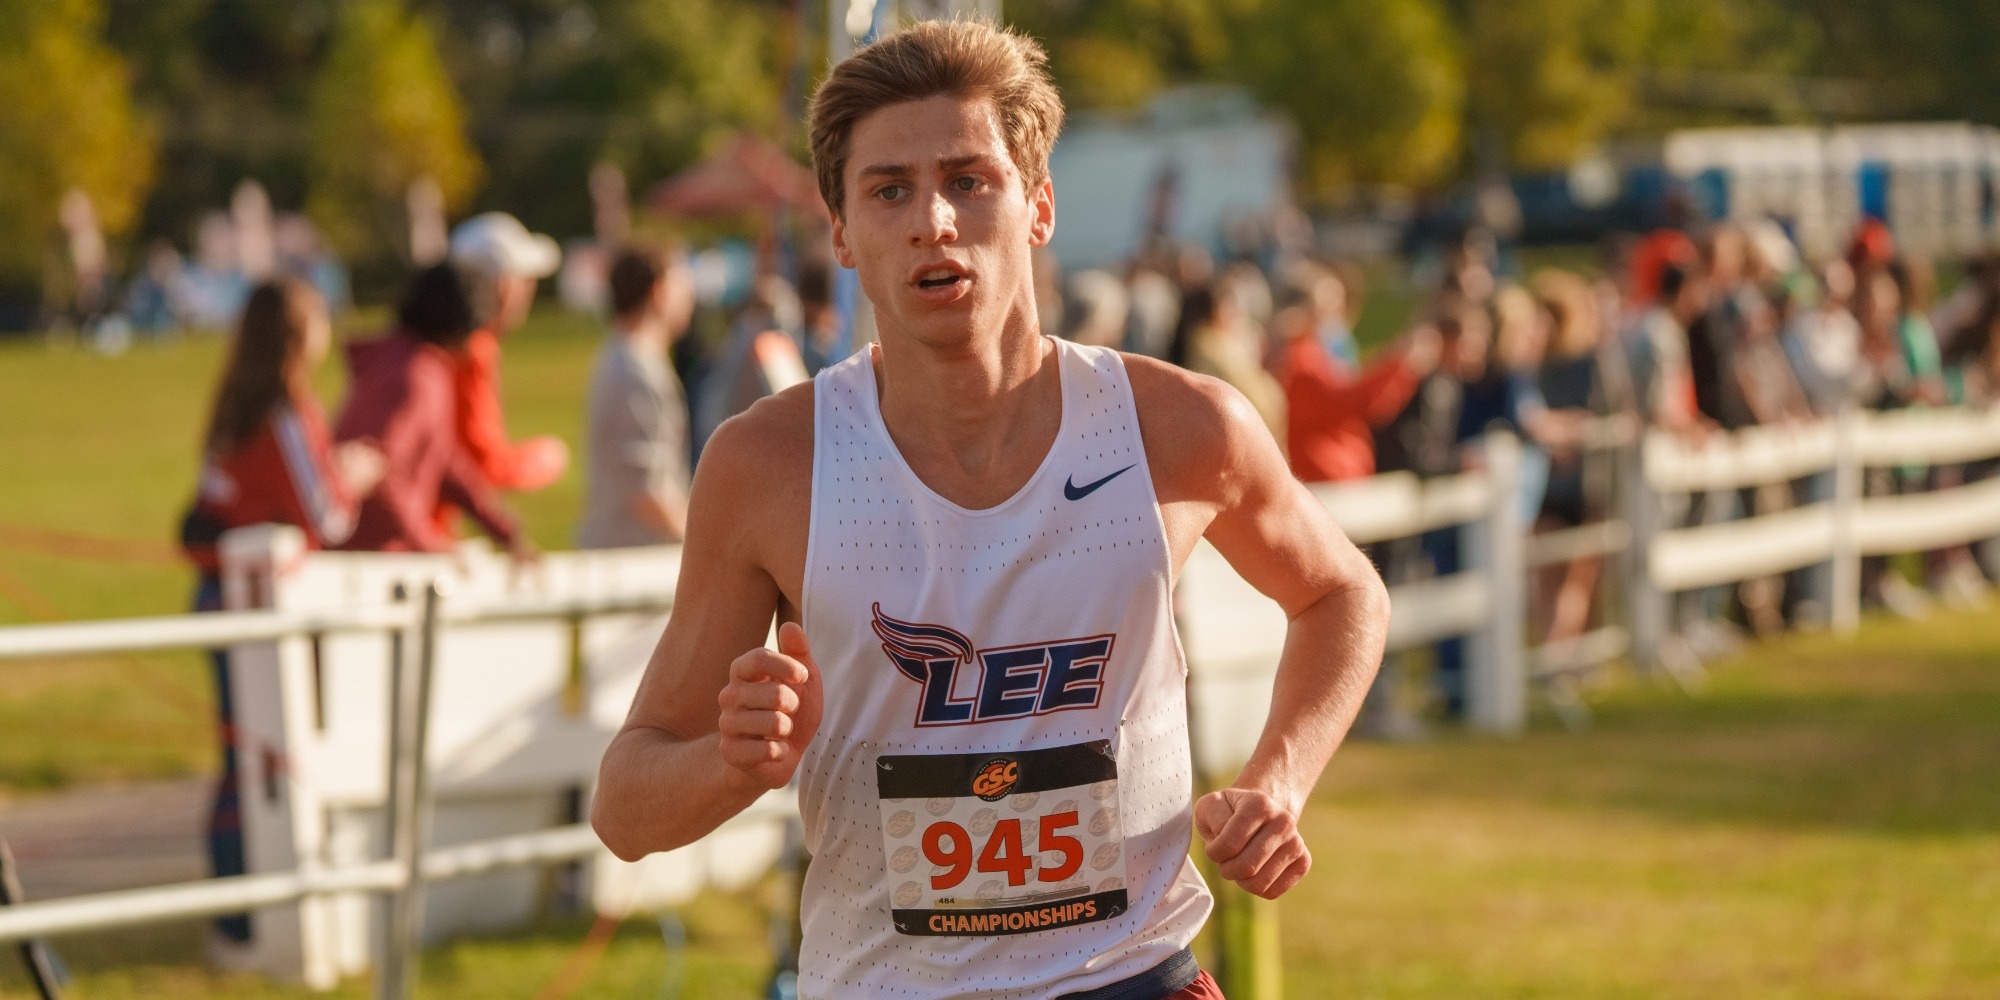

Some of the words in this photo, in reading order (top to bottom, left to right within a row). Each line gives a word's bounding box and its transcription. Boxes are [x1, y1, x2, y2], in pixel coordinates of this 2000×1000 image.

[914, 633, 1116, 728] LEE
[973, 761, 1018, 795] GSC
[921, 811, 1084, 890] 945
[928, 901, 1097, 932] CHAMPIONSHIPS
